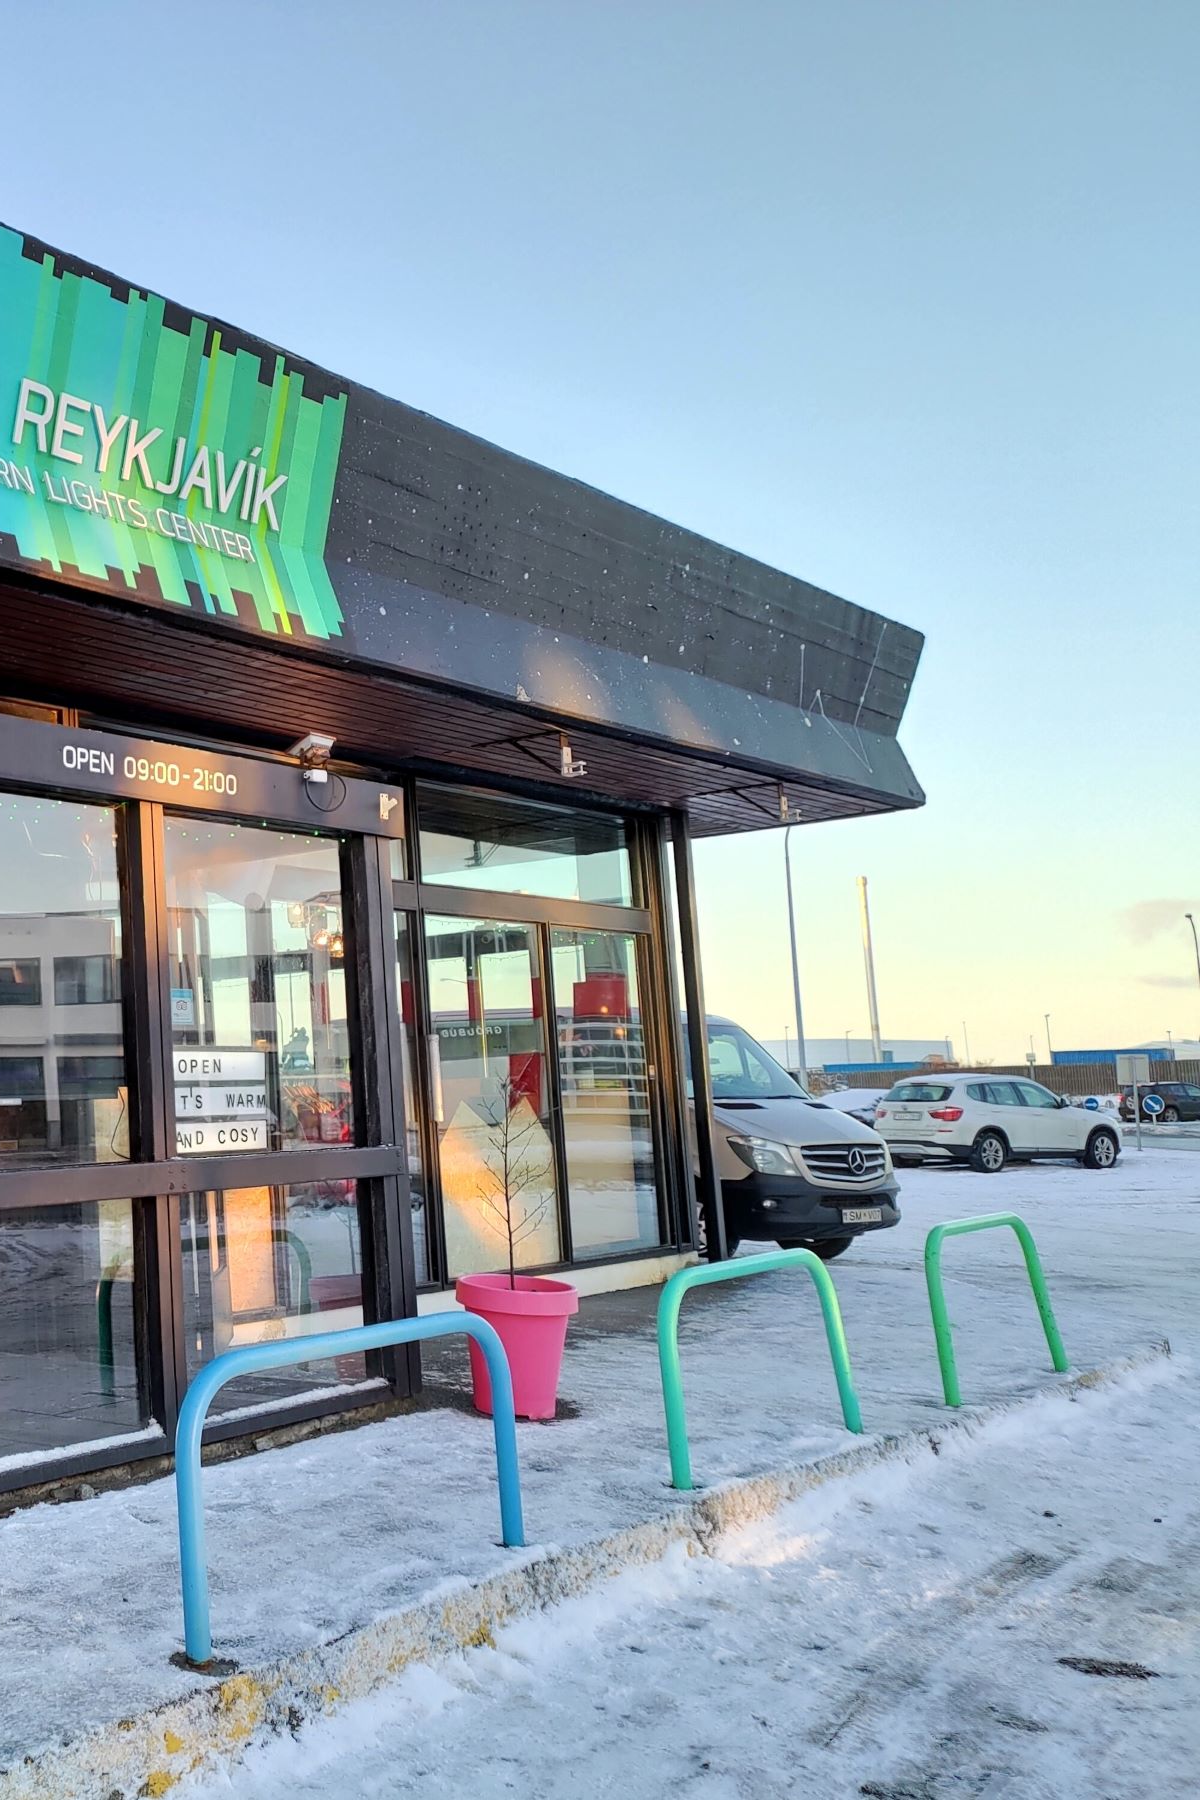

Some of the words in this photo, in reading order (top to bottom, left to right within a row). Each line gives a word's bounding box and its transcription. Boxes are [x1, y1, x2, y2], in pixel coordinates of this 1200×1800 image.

[12, 377, 289, 532] REYKJAVÍK
[41, 471, 148, 532] LIGHTS
[155, 508, 257, 563] CENTER
[62, 745, 115, 775] OPEN
[178, 1059, 222, 1074] OPEN
[225, 1092, 267, 1109] WARM
[176, 1130, 205, 1149] AND
[217, 1127, 259, 1145] COSY
